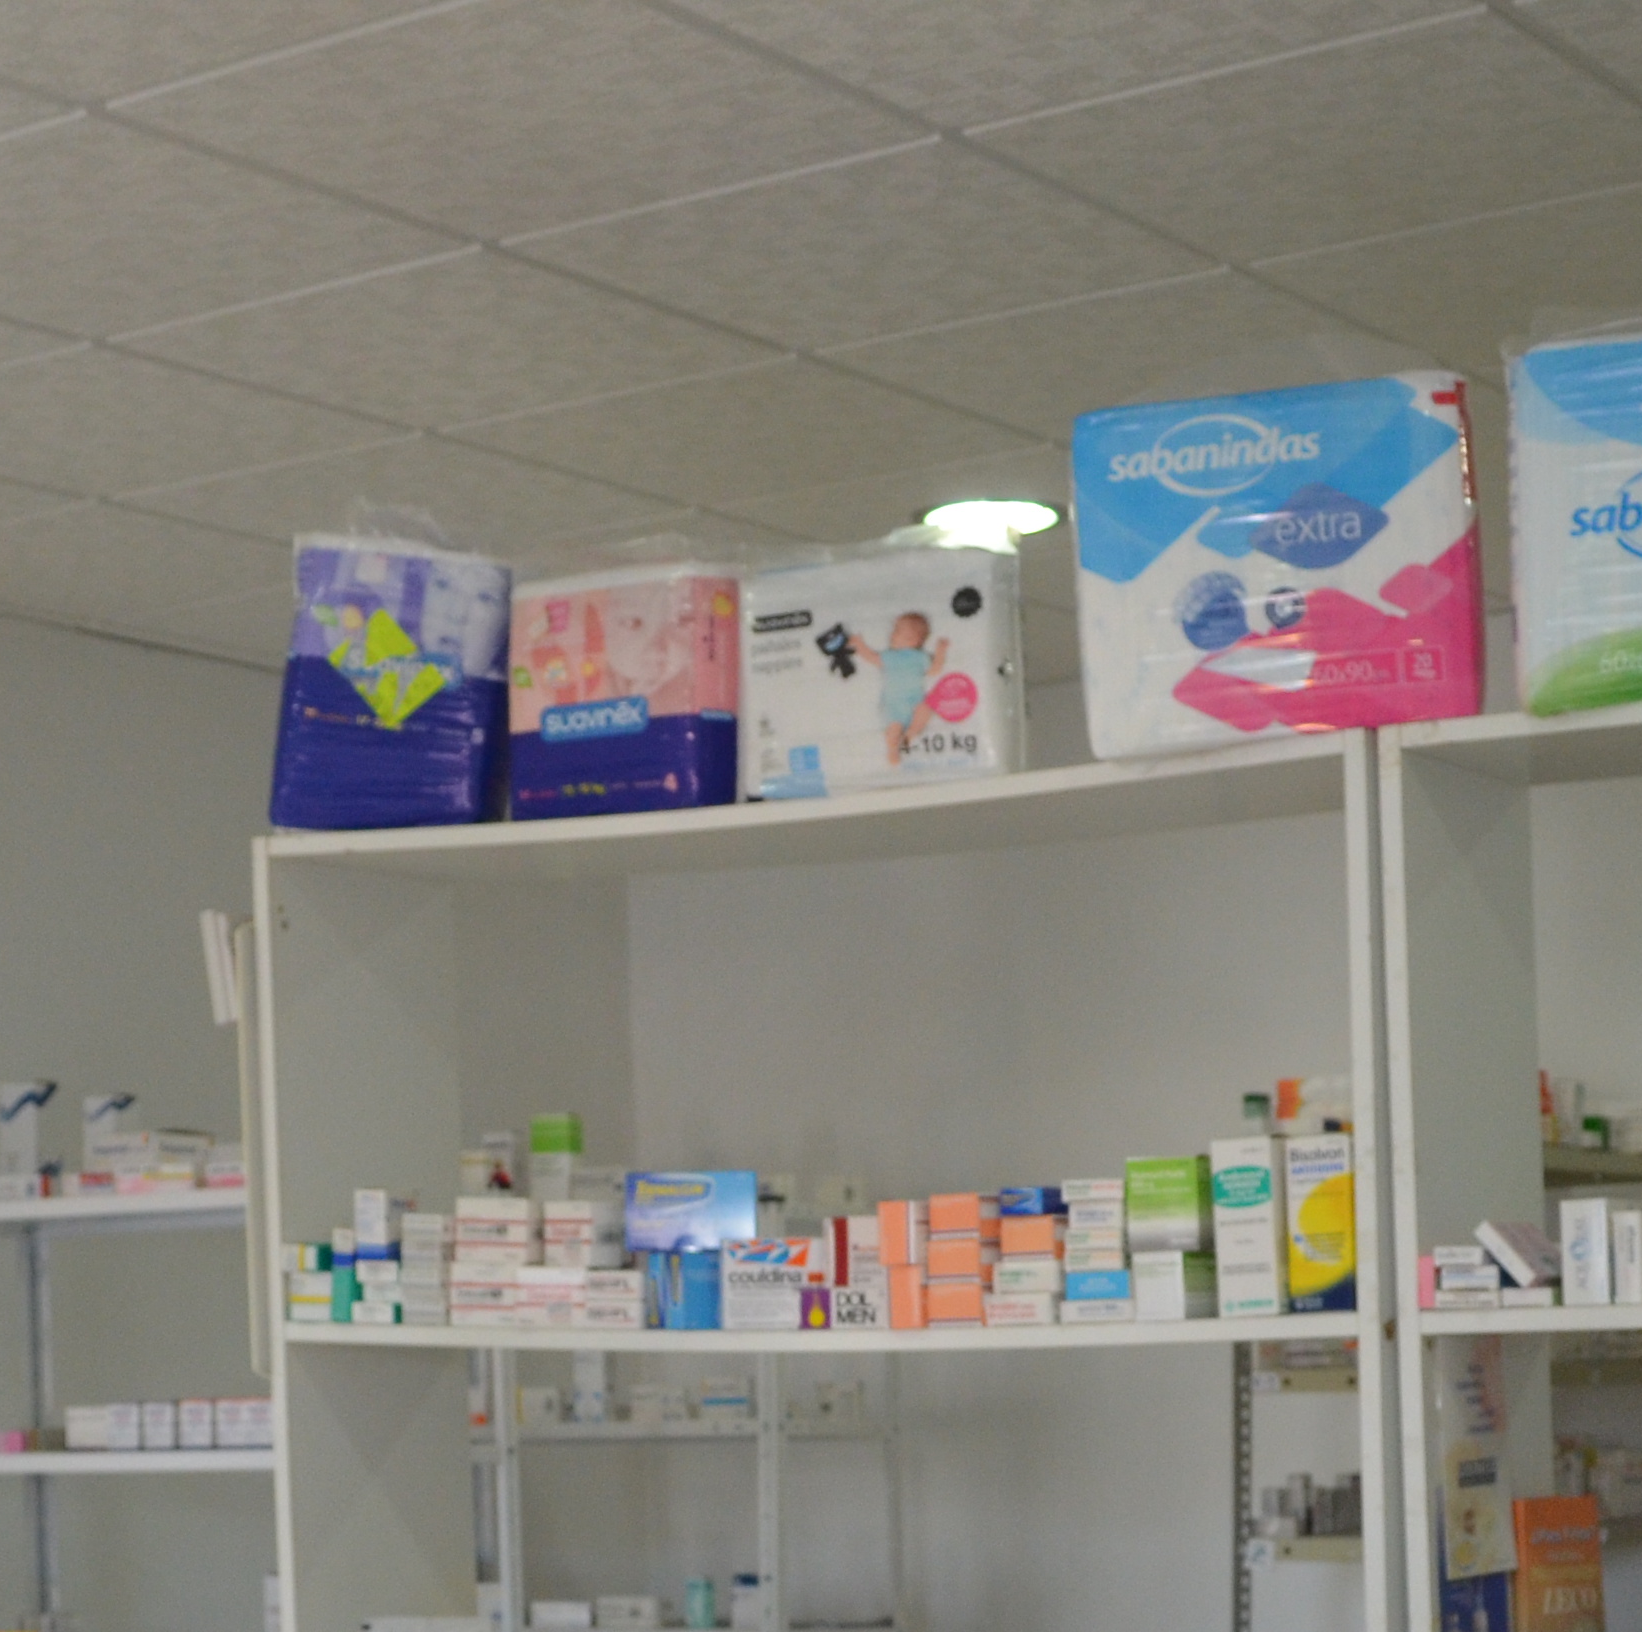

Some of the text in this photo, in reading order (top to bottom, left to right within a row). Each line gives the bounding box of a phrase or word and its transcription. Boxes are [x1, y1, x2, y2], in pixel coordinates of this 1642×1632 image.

[1109, 425, 1320, 483] sabanindas
[1273, 508, 1363, 545] extra
[952, 734, 977, 752] kg
[1288, 1145, 1346, 1163] Bisolvon
[727, 1268, 803, 1286] couldina
[836, 1291, 872, 1307] DOL
[836, 1308, 876, 1324] MEN
